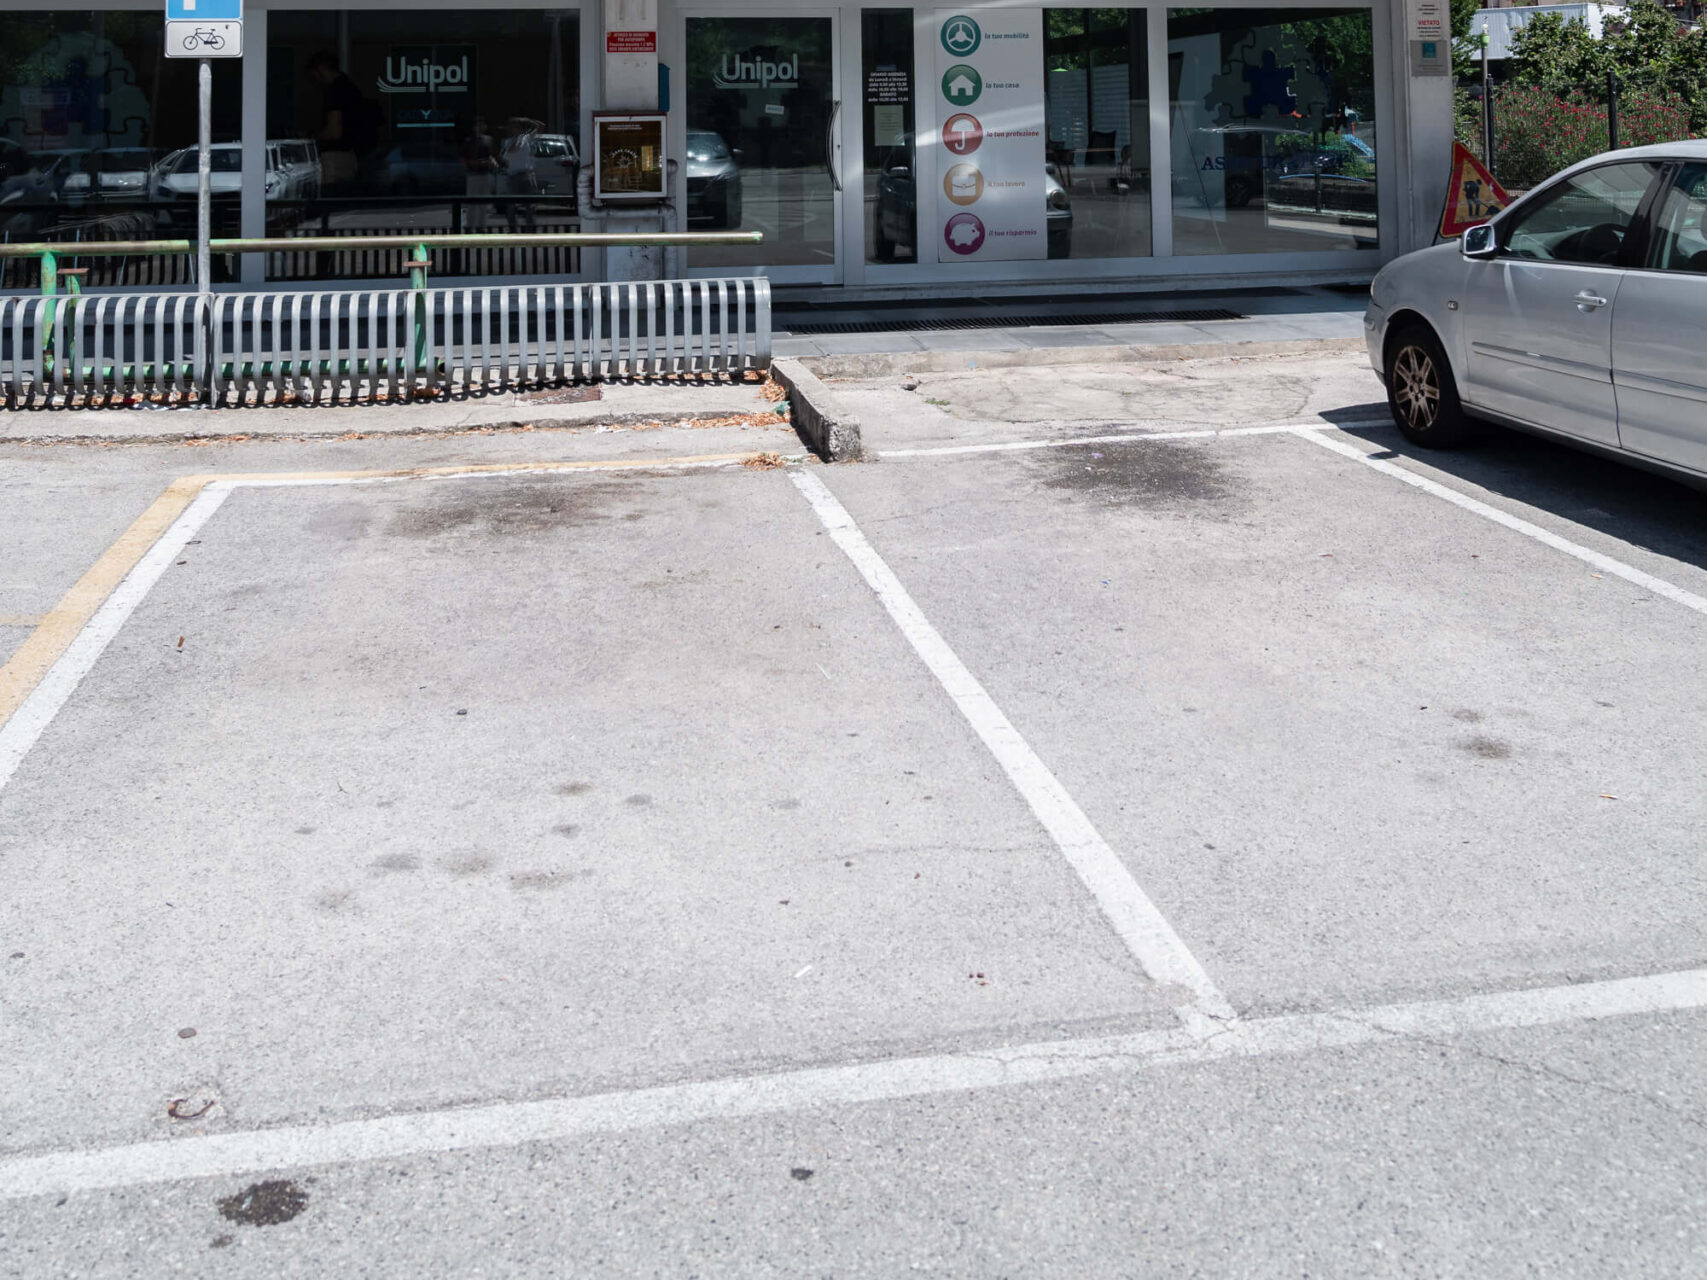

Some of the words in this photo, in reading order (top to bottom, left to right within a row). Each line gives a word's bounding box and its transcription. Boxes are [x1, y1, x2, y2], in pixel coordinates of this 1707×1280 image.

[386, 55, 468, 93] Unipol
[722, 53, 798, 89] Unipol
[1005, 130, 1040, 139] protezione
[1006, 230, 1037, 238] risparmio
